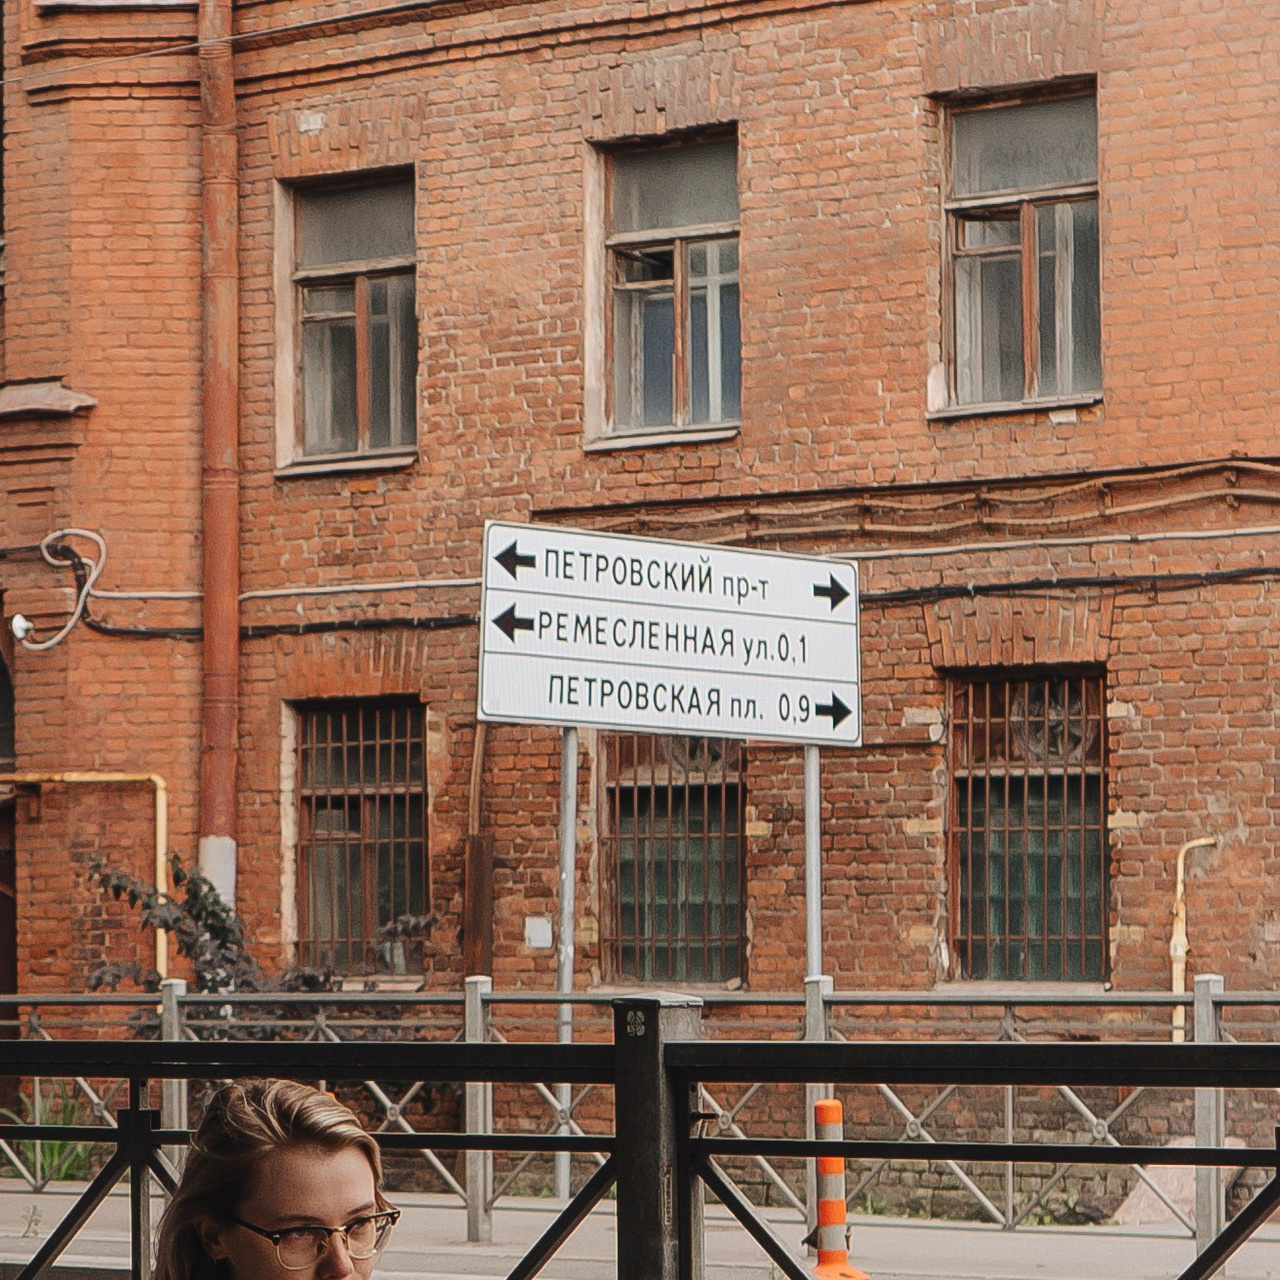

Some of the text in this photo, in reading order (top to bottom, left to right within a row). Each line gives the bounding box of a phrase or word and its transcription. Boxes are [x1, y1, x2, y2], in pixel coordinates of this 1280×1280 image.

[544, 549, 769, 606] ПЕТРОВСКИЙ пр-т
[538, 611, 735, 657] РЕМЕСЛЕННАЯ
[548, 675, 810, 724] ПЕТРОВСКАЯ пл. 0,9
